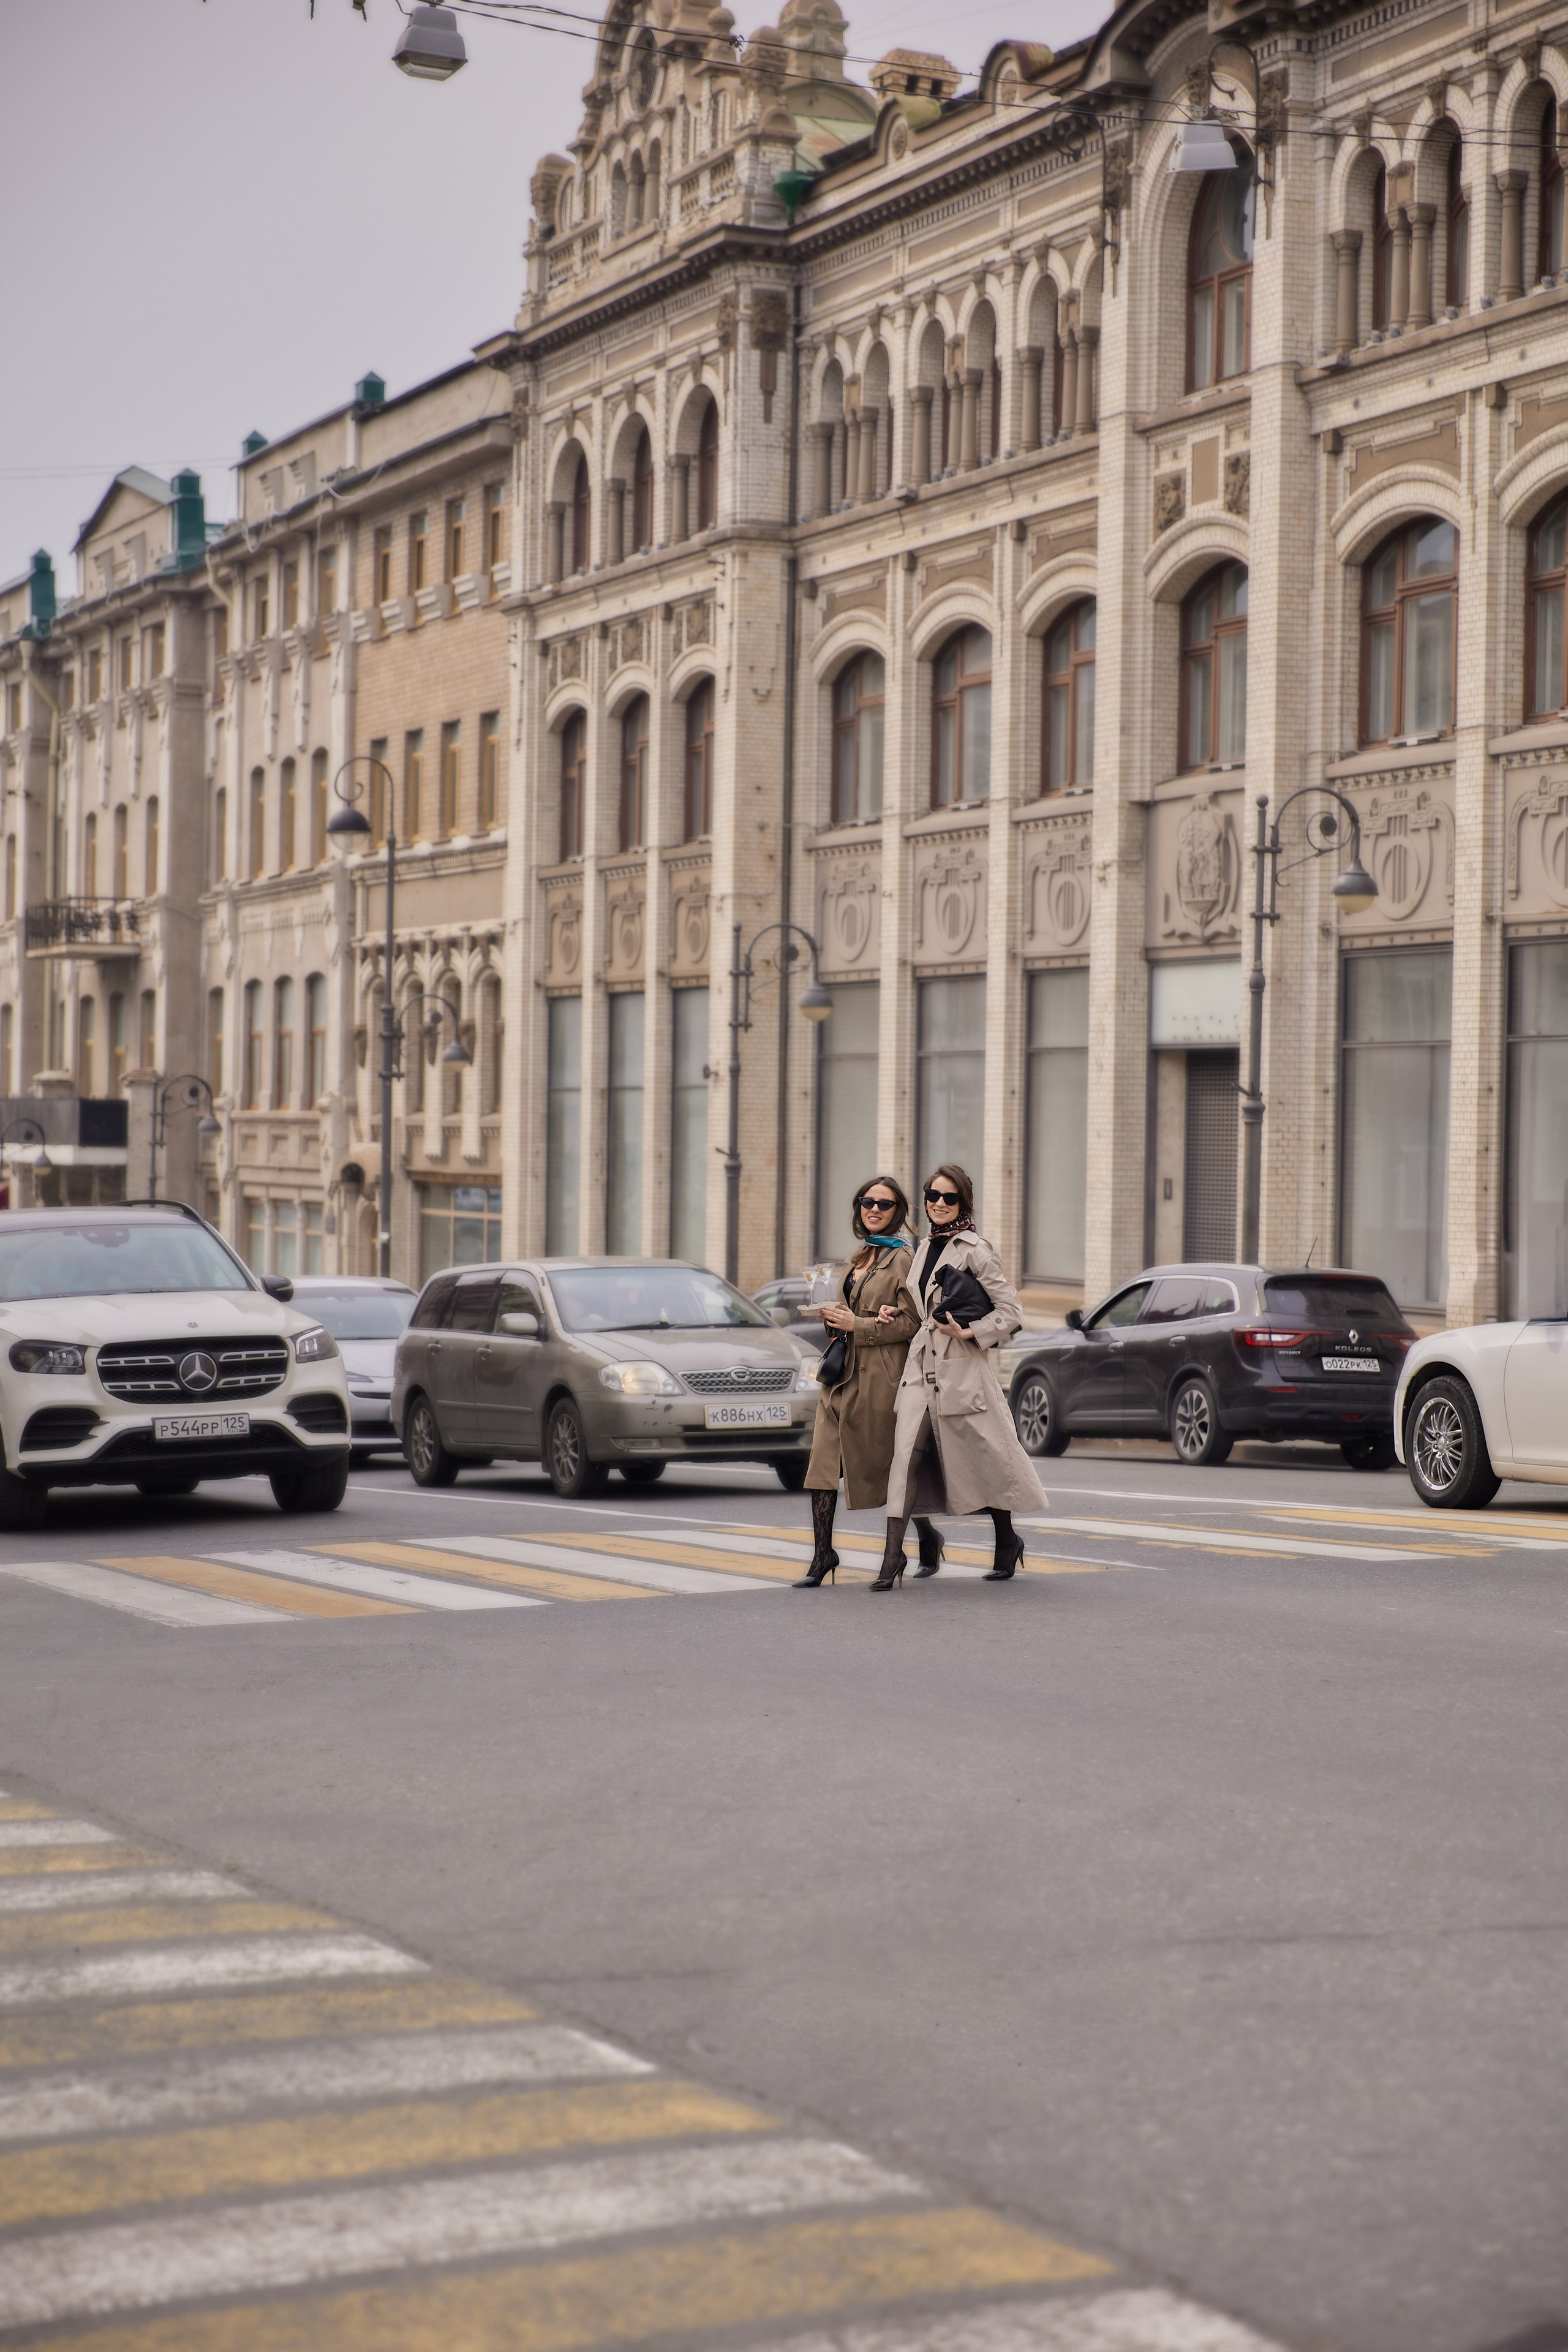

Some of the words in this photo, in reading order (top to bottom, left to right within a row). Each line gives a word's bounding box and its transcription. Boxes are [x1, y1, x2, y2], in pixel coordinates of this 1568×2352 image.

[1325, 1359, 1362, 1369] О022РК
[712, 1408, 764, 1422] К886НХ
[766, 1406, 785, 1417] 125
[160, 1420, 219, 1436] Р544РР
[223, 1416, 244, 1428] 125
